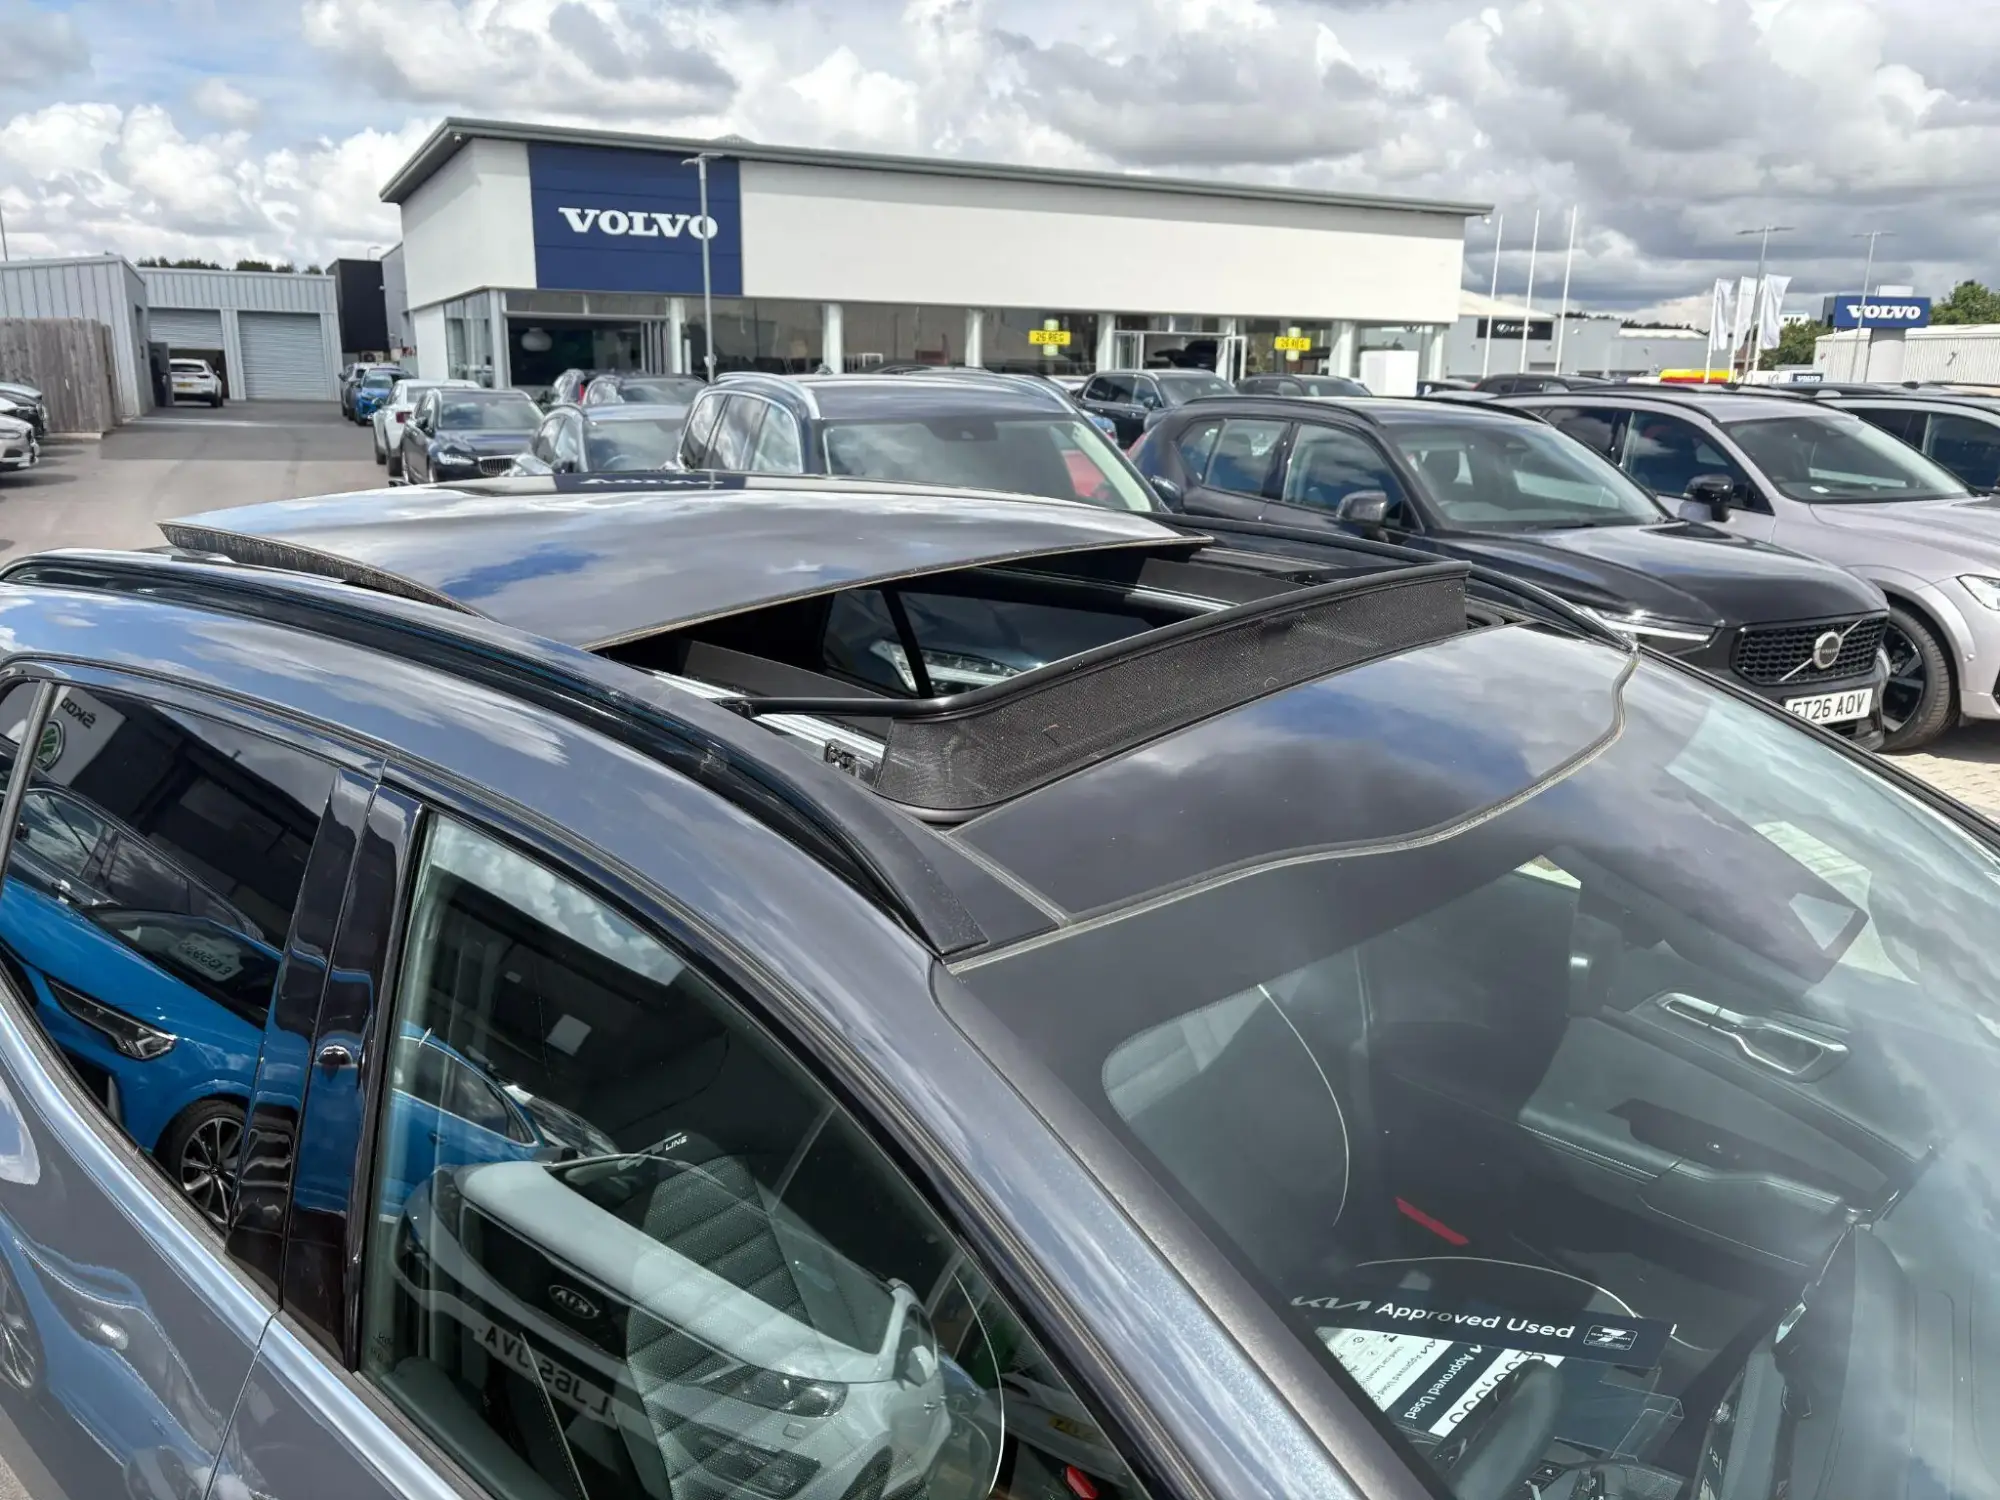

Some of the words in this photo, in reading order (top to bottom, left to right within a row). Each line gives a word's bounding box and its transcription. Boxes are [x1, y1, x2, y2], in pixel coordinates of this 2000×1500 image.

[558, 207, 718, 240] VOLVO
[1846, 305, 1921, 319] VOLVO
[1835, 693, 1866, 716] AOV
[665, 1135, 687, 1151] LINE
[1375, 1302, 1501, 1328] Approved
[1506, 1317, 1575, 1338] Used
[1428, 1354, 1475, 1395] Approved
[1404, 1395, 1437, 1419] Used
